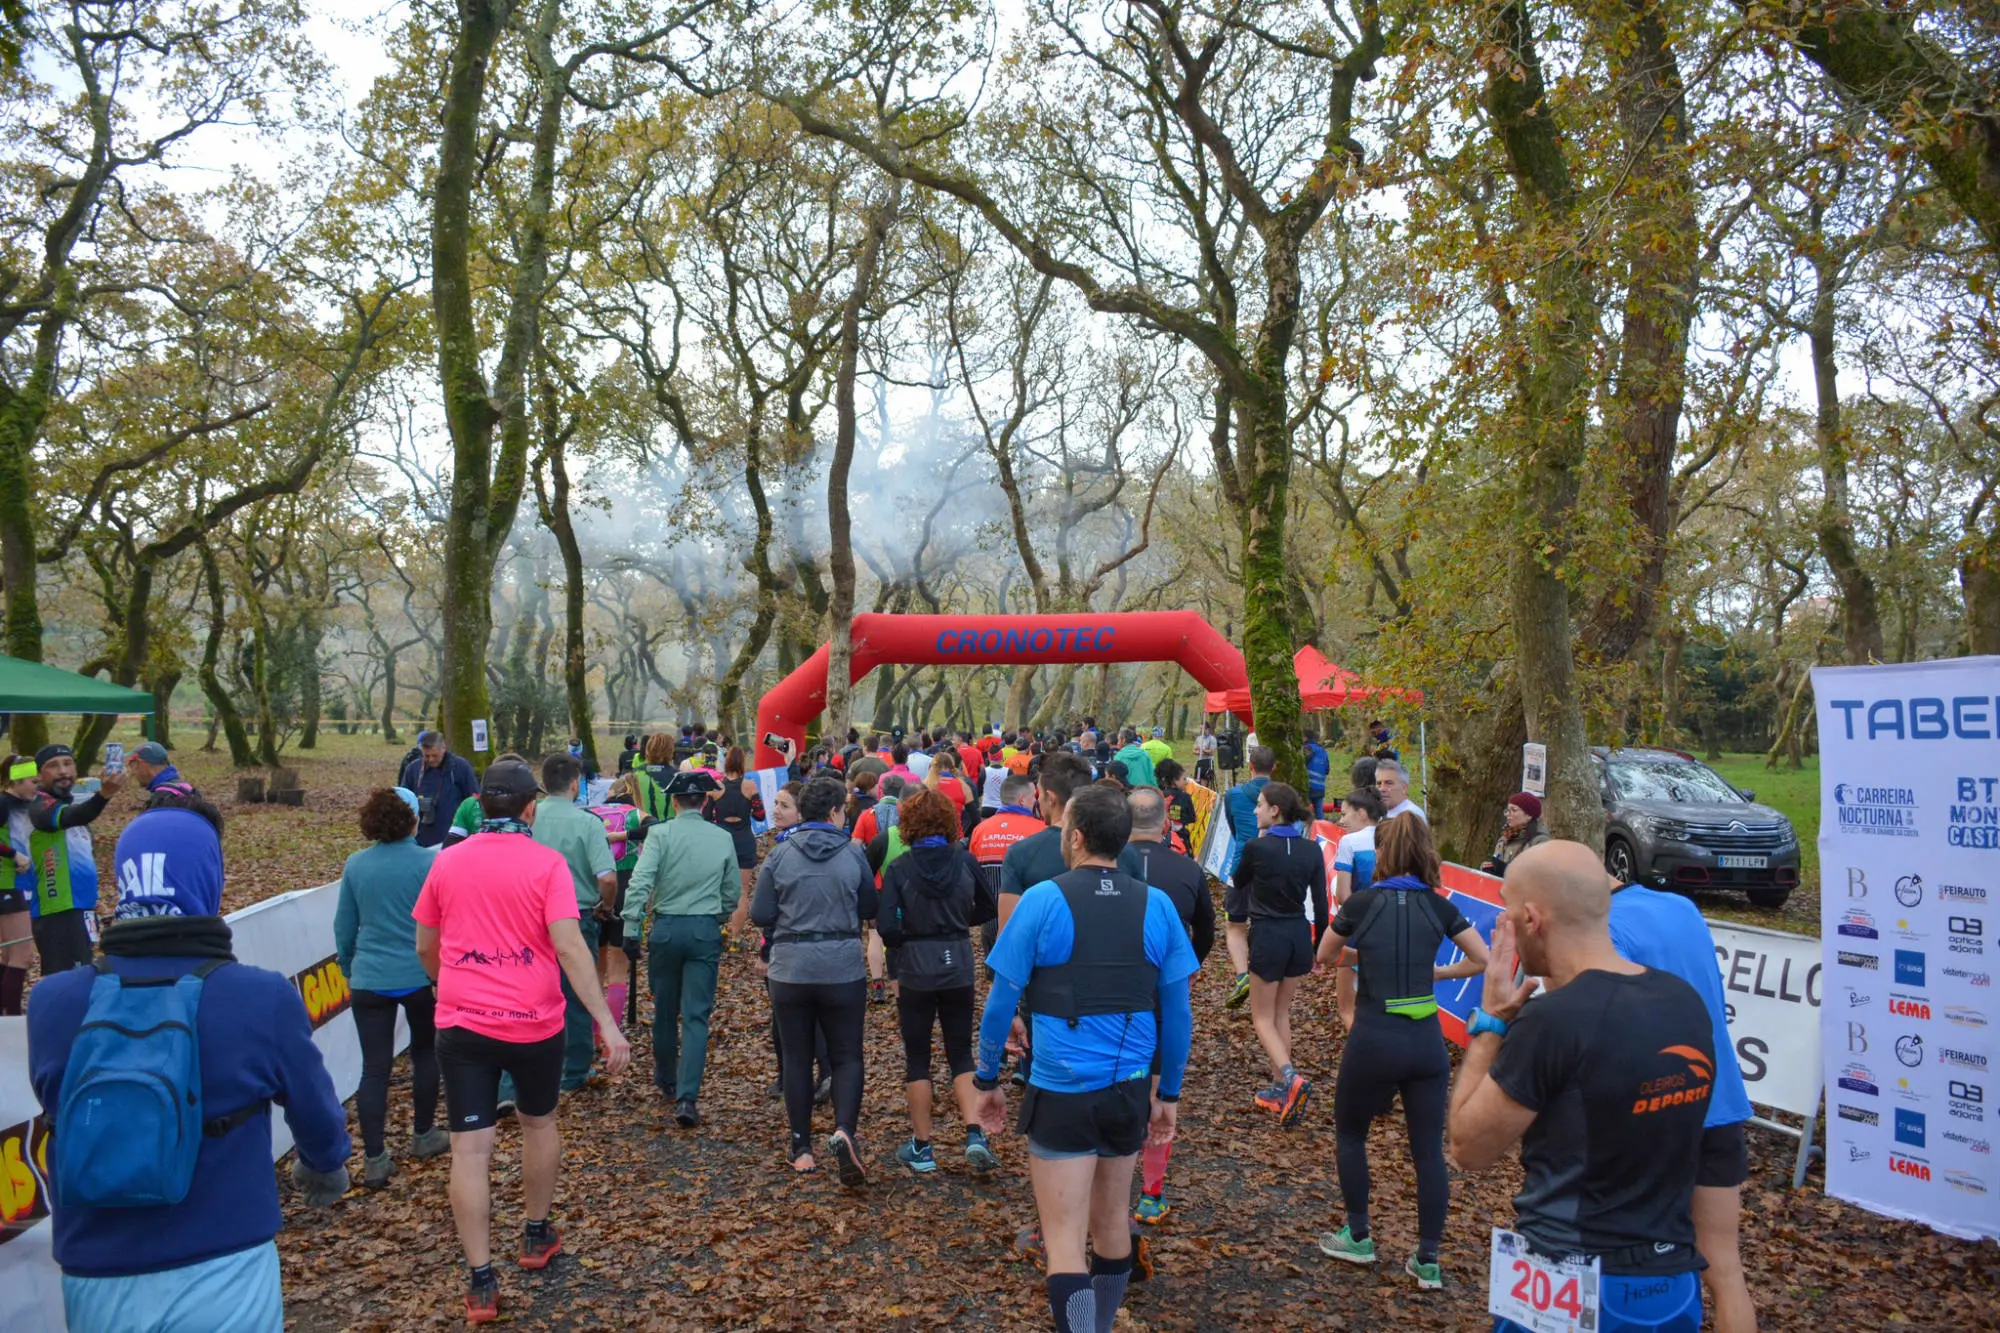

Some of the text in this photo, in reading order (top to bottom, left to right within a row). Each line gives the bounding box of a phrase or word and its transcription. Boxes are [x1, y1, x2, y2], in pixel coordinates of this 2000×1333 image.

[936, 626, 1116, 654] CRONOTEC
[1830, 696, 2000, 740] TABE
[1857, 787, 1914, 805] CARREIRA
[1839, 806, 1903, 826] NOCTURNA
[1950, 805, 2000, 825] MON
[1949, 826, 2000, 848] CAST
[118, 852, 175, 901] AIL
[1944, 885, 1986, 898] FEIRAUTO
[1889, 999, 1931, 1020] LEMA
[1945, 1049, 1987, 1066] FEIRAUTO
[1889, 1156, 1931, 1182] LEMA
[1510, 1259, 1582, 1320] 204
